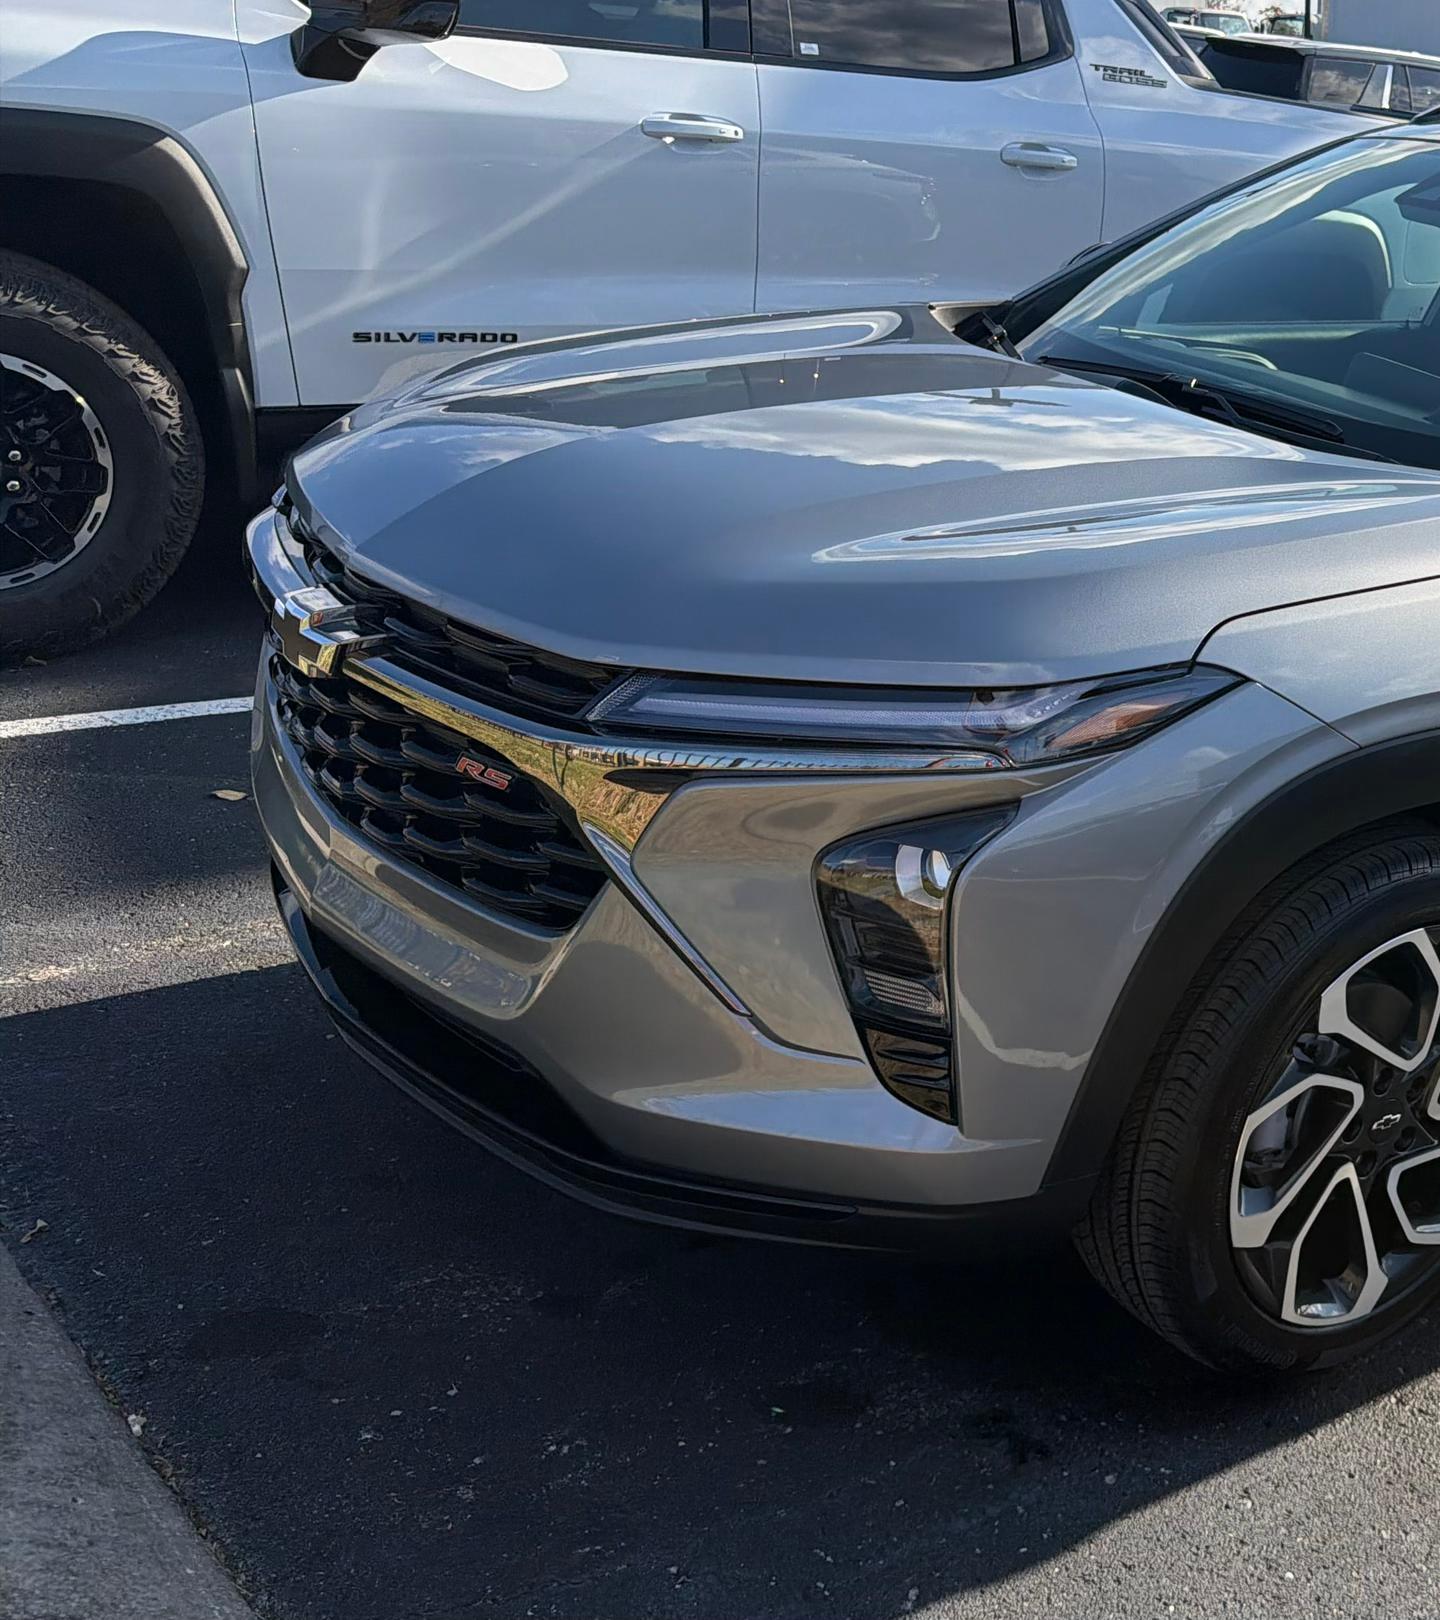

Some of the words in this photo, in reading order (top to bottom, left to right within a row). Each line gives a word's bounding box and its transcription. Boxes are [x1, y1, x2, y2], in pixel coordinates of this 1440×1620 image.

[1089, 63, 1153, 79] TRAIL
[1102, 73, 1168, 89] BOSS
[352, 331, 518, 344] SILVERADO
[455, 756, 513, 791] RS
